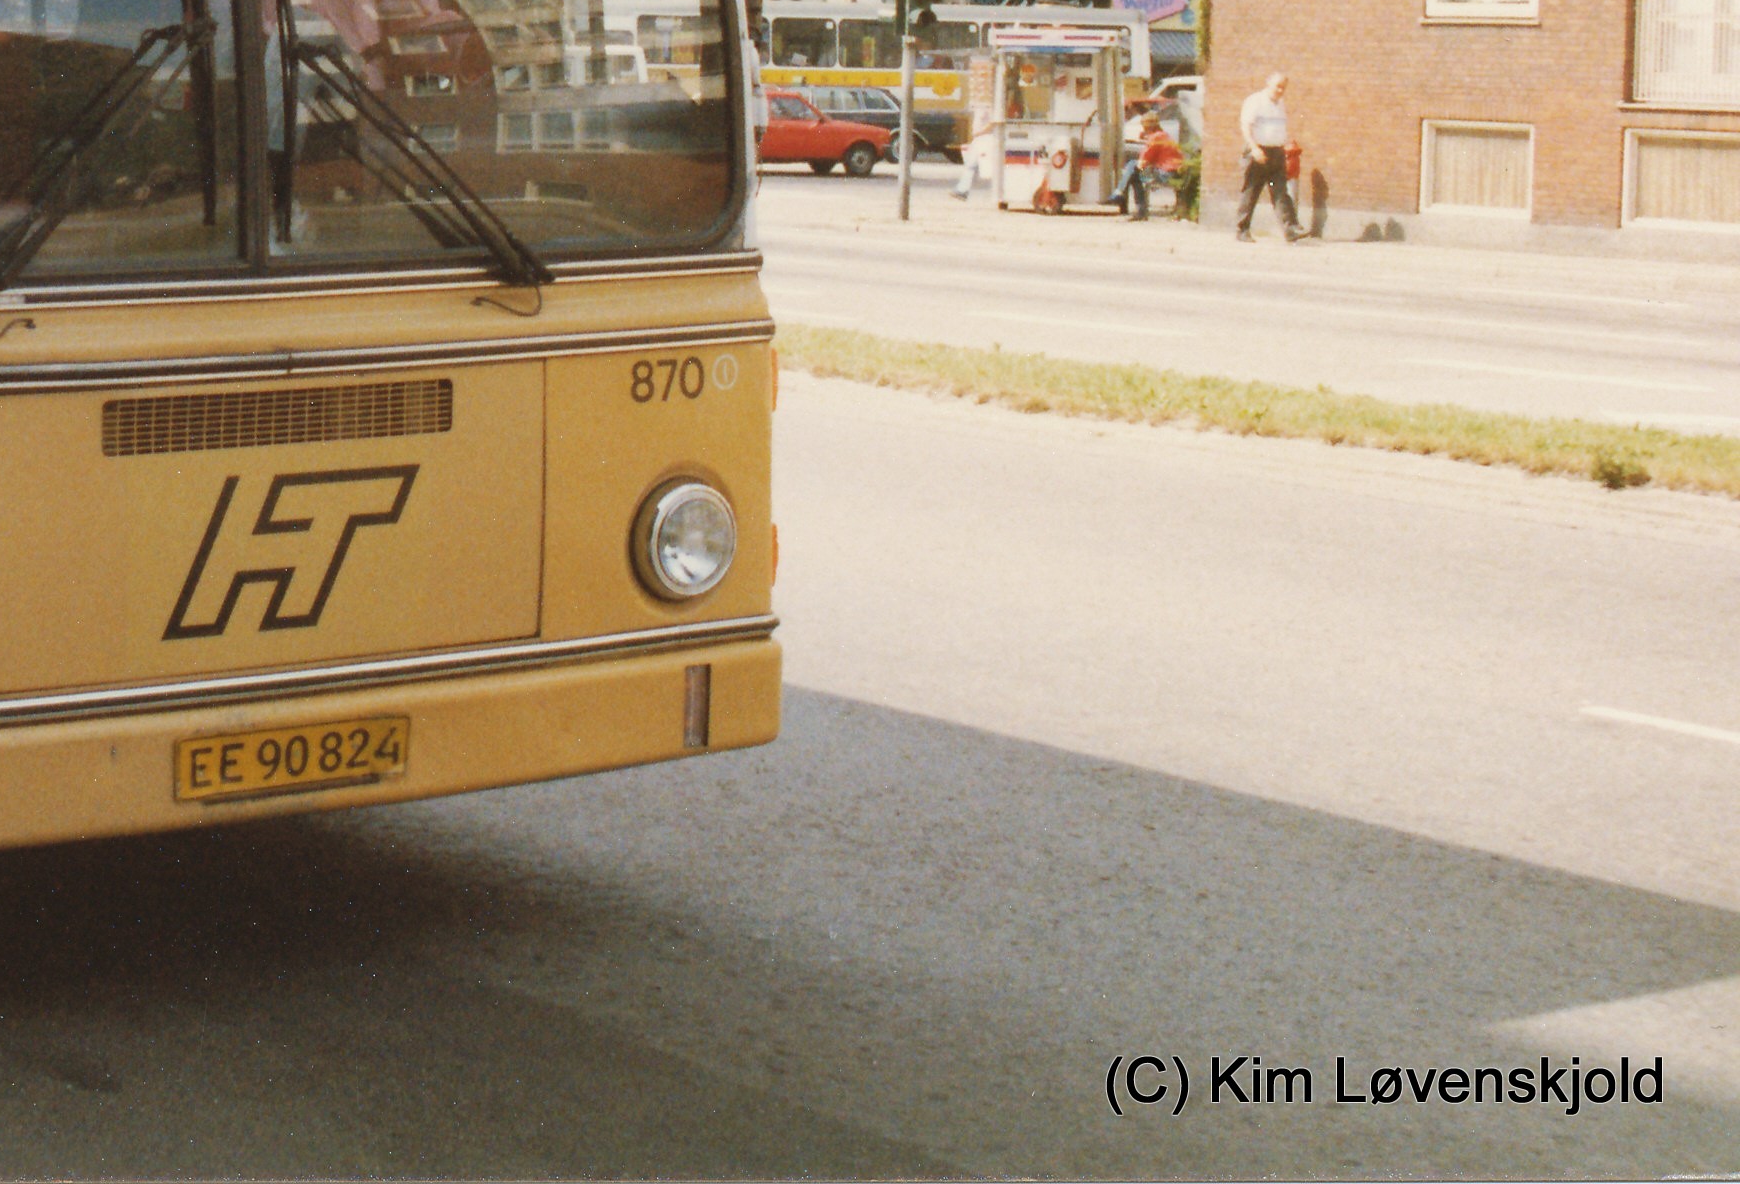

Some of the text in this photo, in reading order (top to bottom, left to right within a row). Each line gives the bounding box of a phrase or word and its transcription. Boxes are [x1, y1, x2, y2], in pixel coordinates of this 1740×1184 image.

[631, 356, 705, 403] 870
[162, 463, 420, 640] HT
[189, 727, 401, 789] EE 90 824
